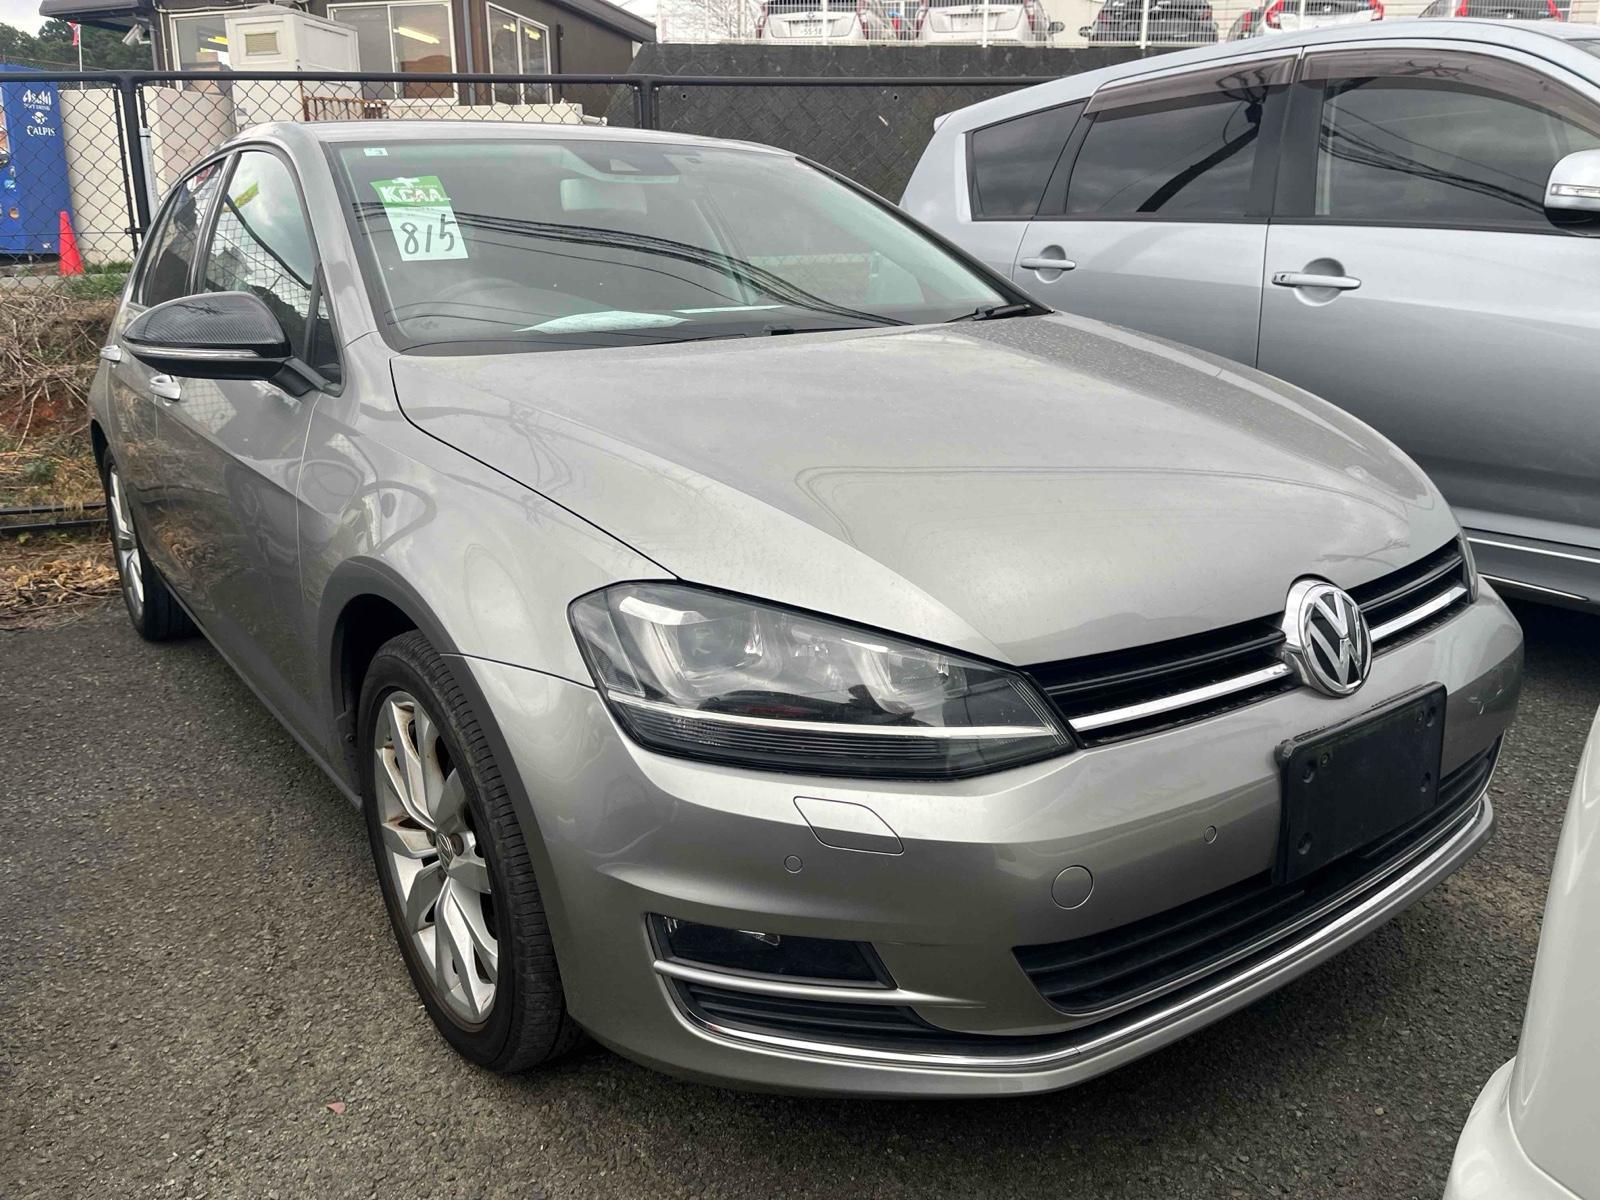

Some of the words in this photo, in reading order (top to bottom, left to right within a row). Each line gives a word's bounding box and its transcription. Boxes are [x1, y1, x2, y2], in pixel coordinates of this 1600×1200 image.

[22, 89, 52, 106] Asahi
[26, 125, 56, 137] CALPIS
[400, 213, 457, 255] 815
